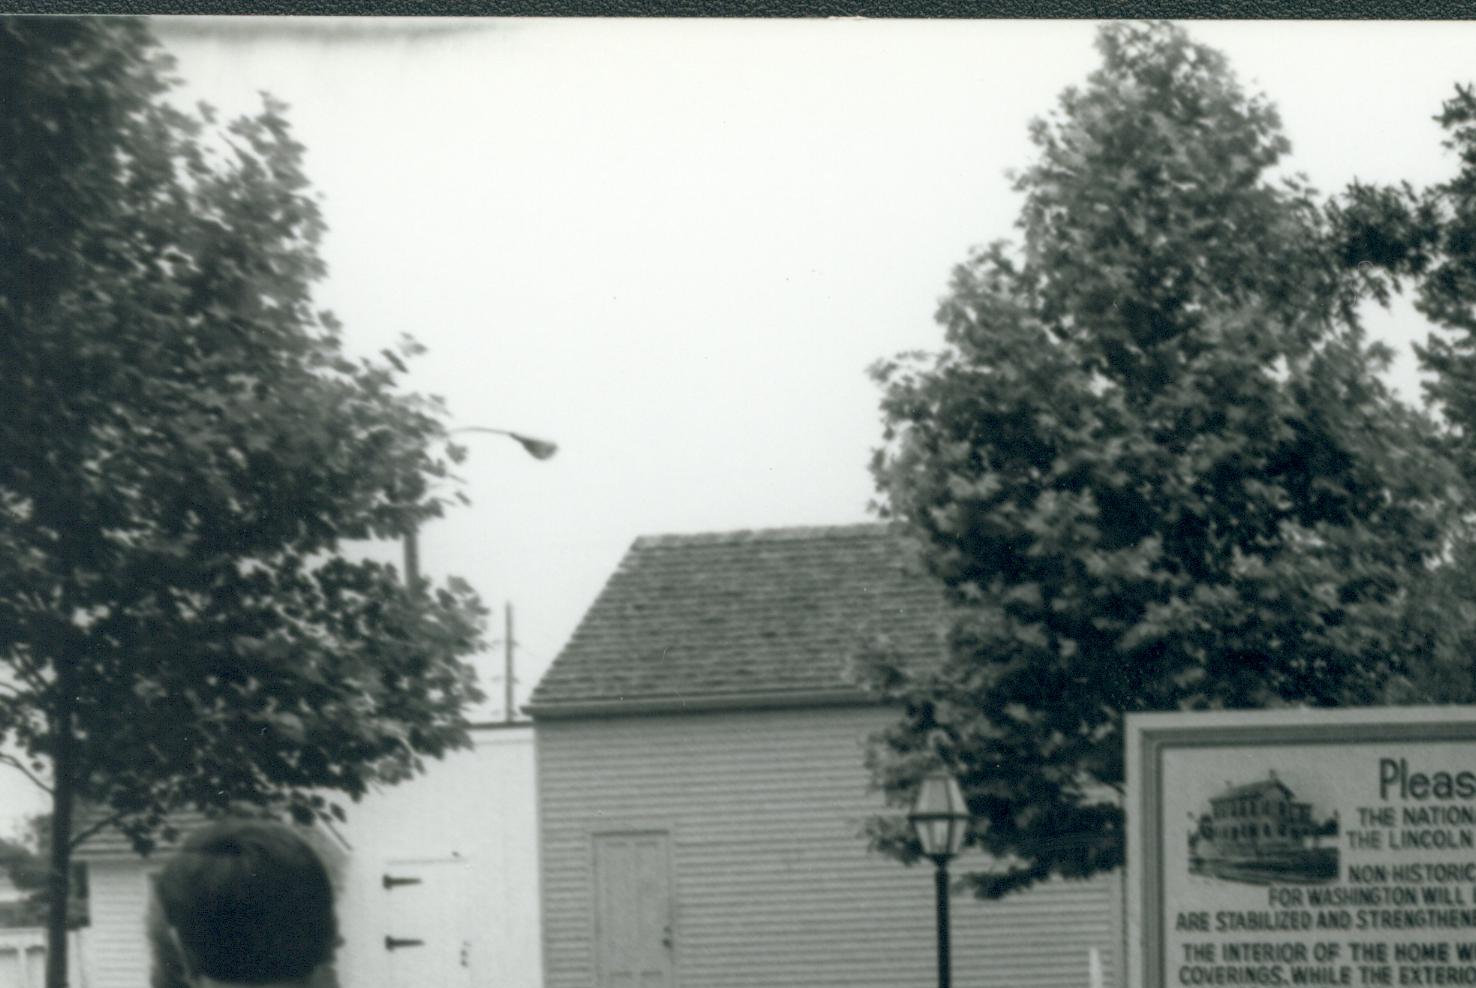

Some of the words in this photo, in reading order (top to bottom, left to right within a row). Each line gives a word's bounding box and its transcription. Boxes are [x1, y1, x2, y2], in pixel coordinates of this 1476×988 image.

[1358, 807, 1395, 827] THE
[1346, 830, 1383, 850] THE
[1389, 828, 1474, 850] LINCOLN
[1269, 887, 1303, 907] FOR
[1307, 886, 1418, 907] WASHINGTON
[1421, 885, 1465, 905] WILL
[1176, 911, 1210, 932] ARE
[1215, 910, 1312, 932] STABILIZED
[1316, 910, 1352, 931] AND
[1182, 943, 1216, 964] THE
[1222, 943, 1308, 964] INTERIOR
[1313, 942, 1341, 963] OF
[1348, 942, 1387, 963] THE
[1394, 941, 1450, 962] HOME
[1291, 966, 1352, 985] WHILE
[1358, 965, 1392, 985] THE
